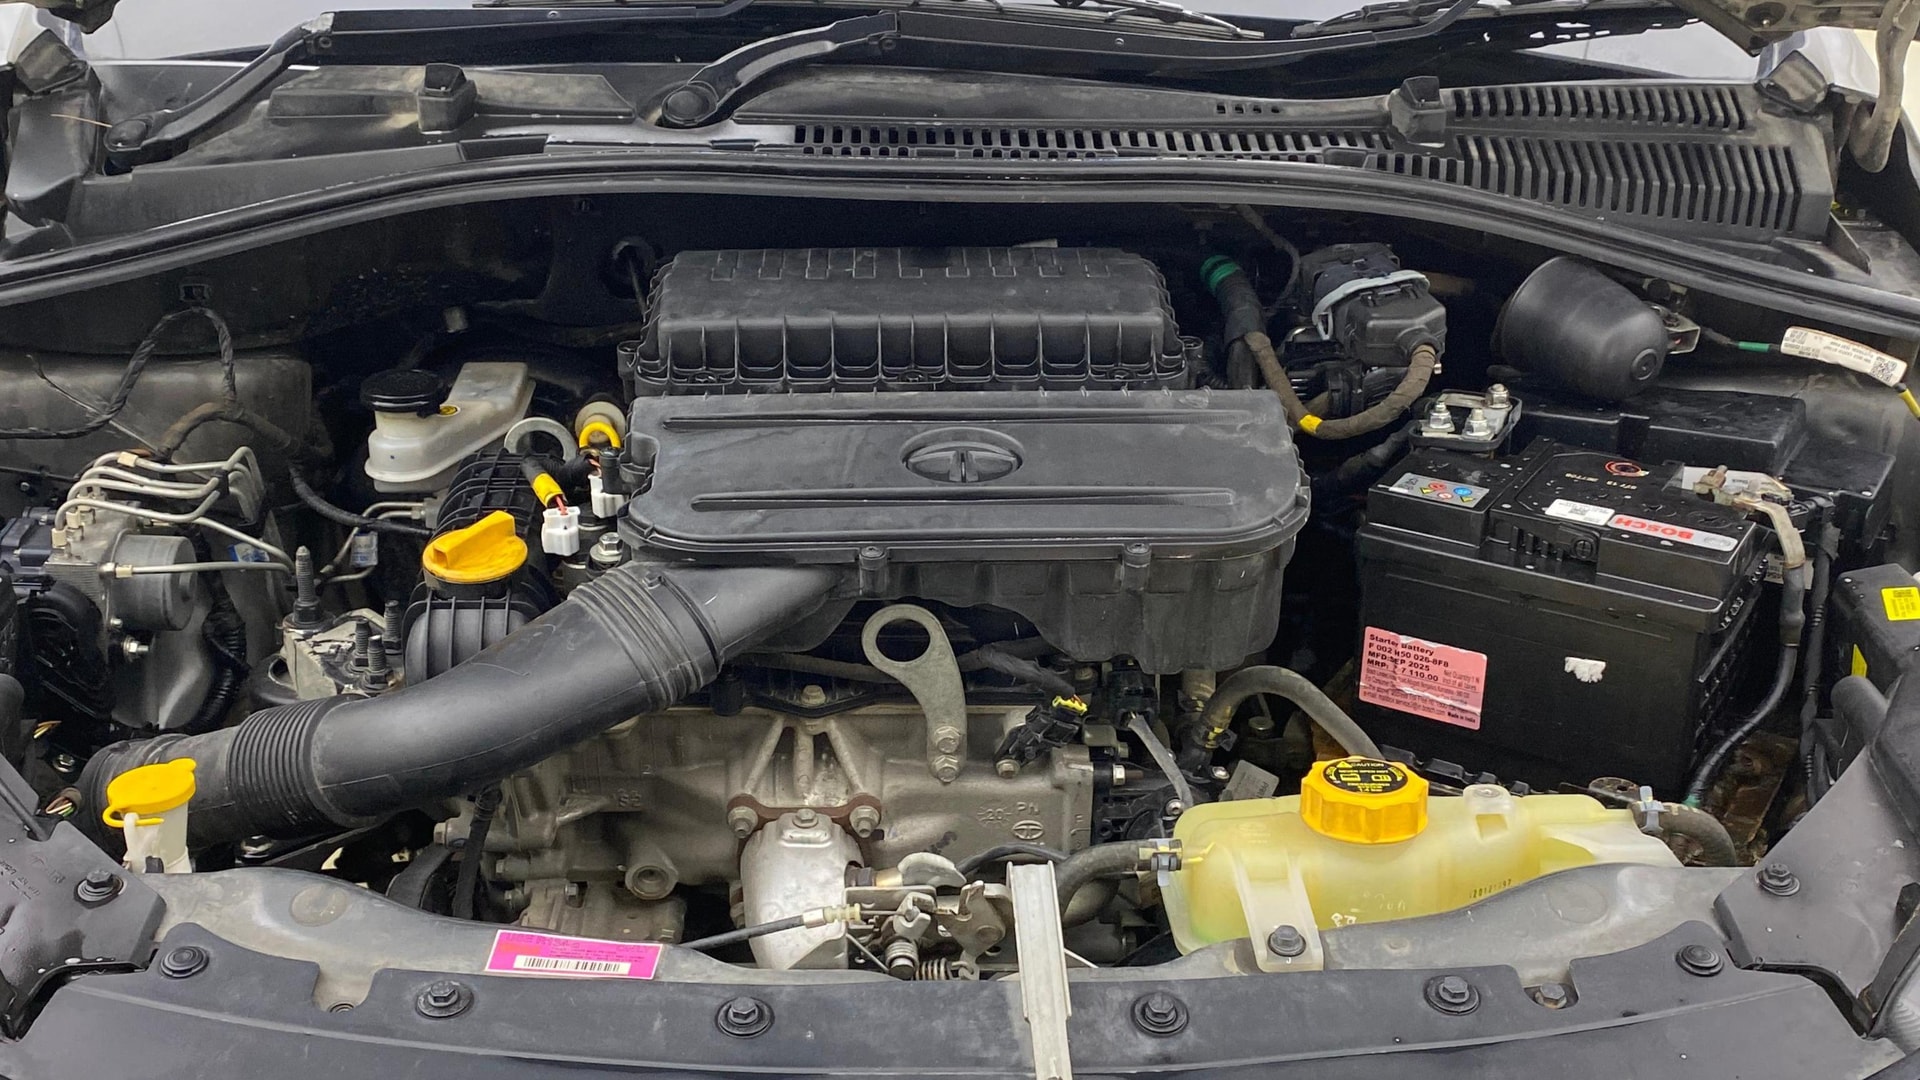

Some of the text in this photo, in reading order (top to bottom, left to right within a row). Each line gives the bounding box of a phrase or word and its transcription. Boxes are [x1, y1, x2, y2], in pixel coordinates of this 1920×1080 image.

[1614, 517, 1694, 541] BOSCH
[1369, 634, 1399, 648] Starter
[1376, 644, 1393, 654] 002
[1408, 660, 1430, 672] 2025
